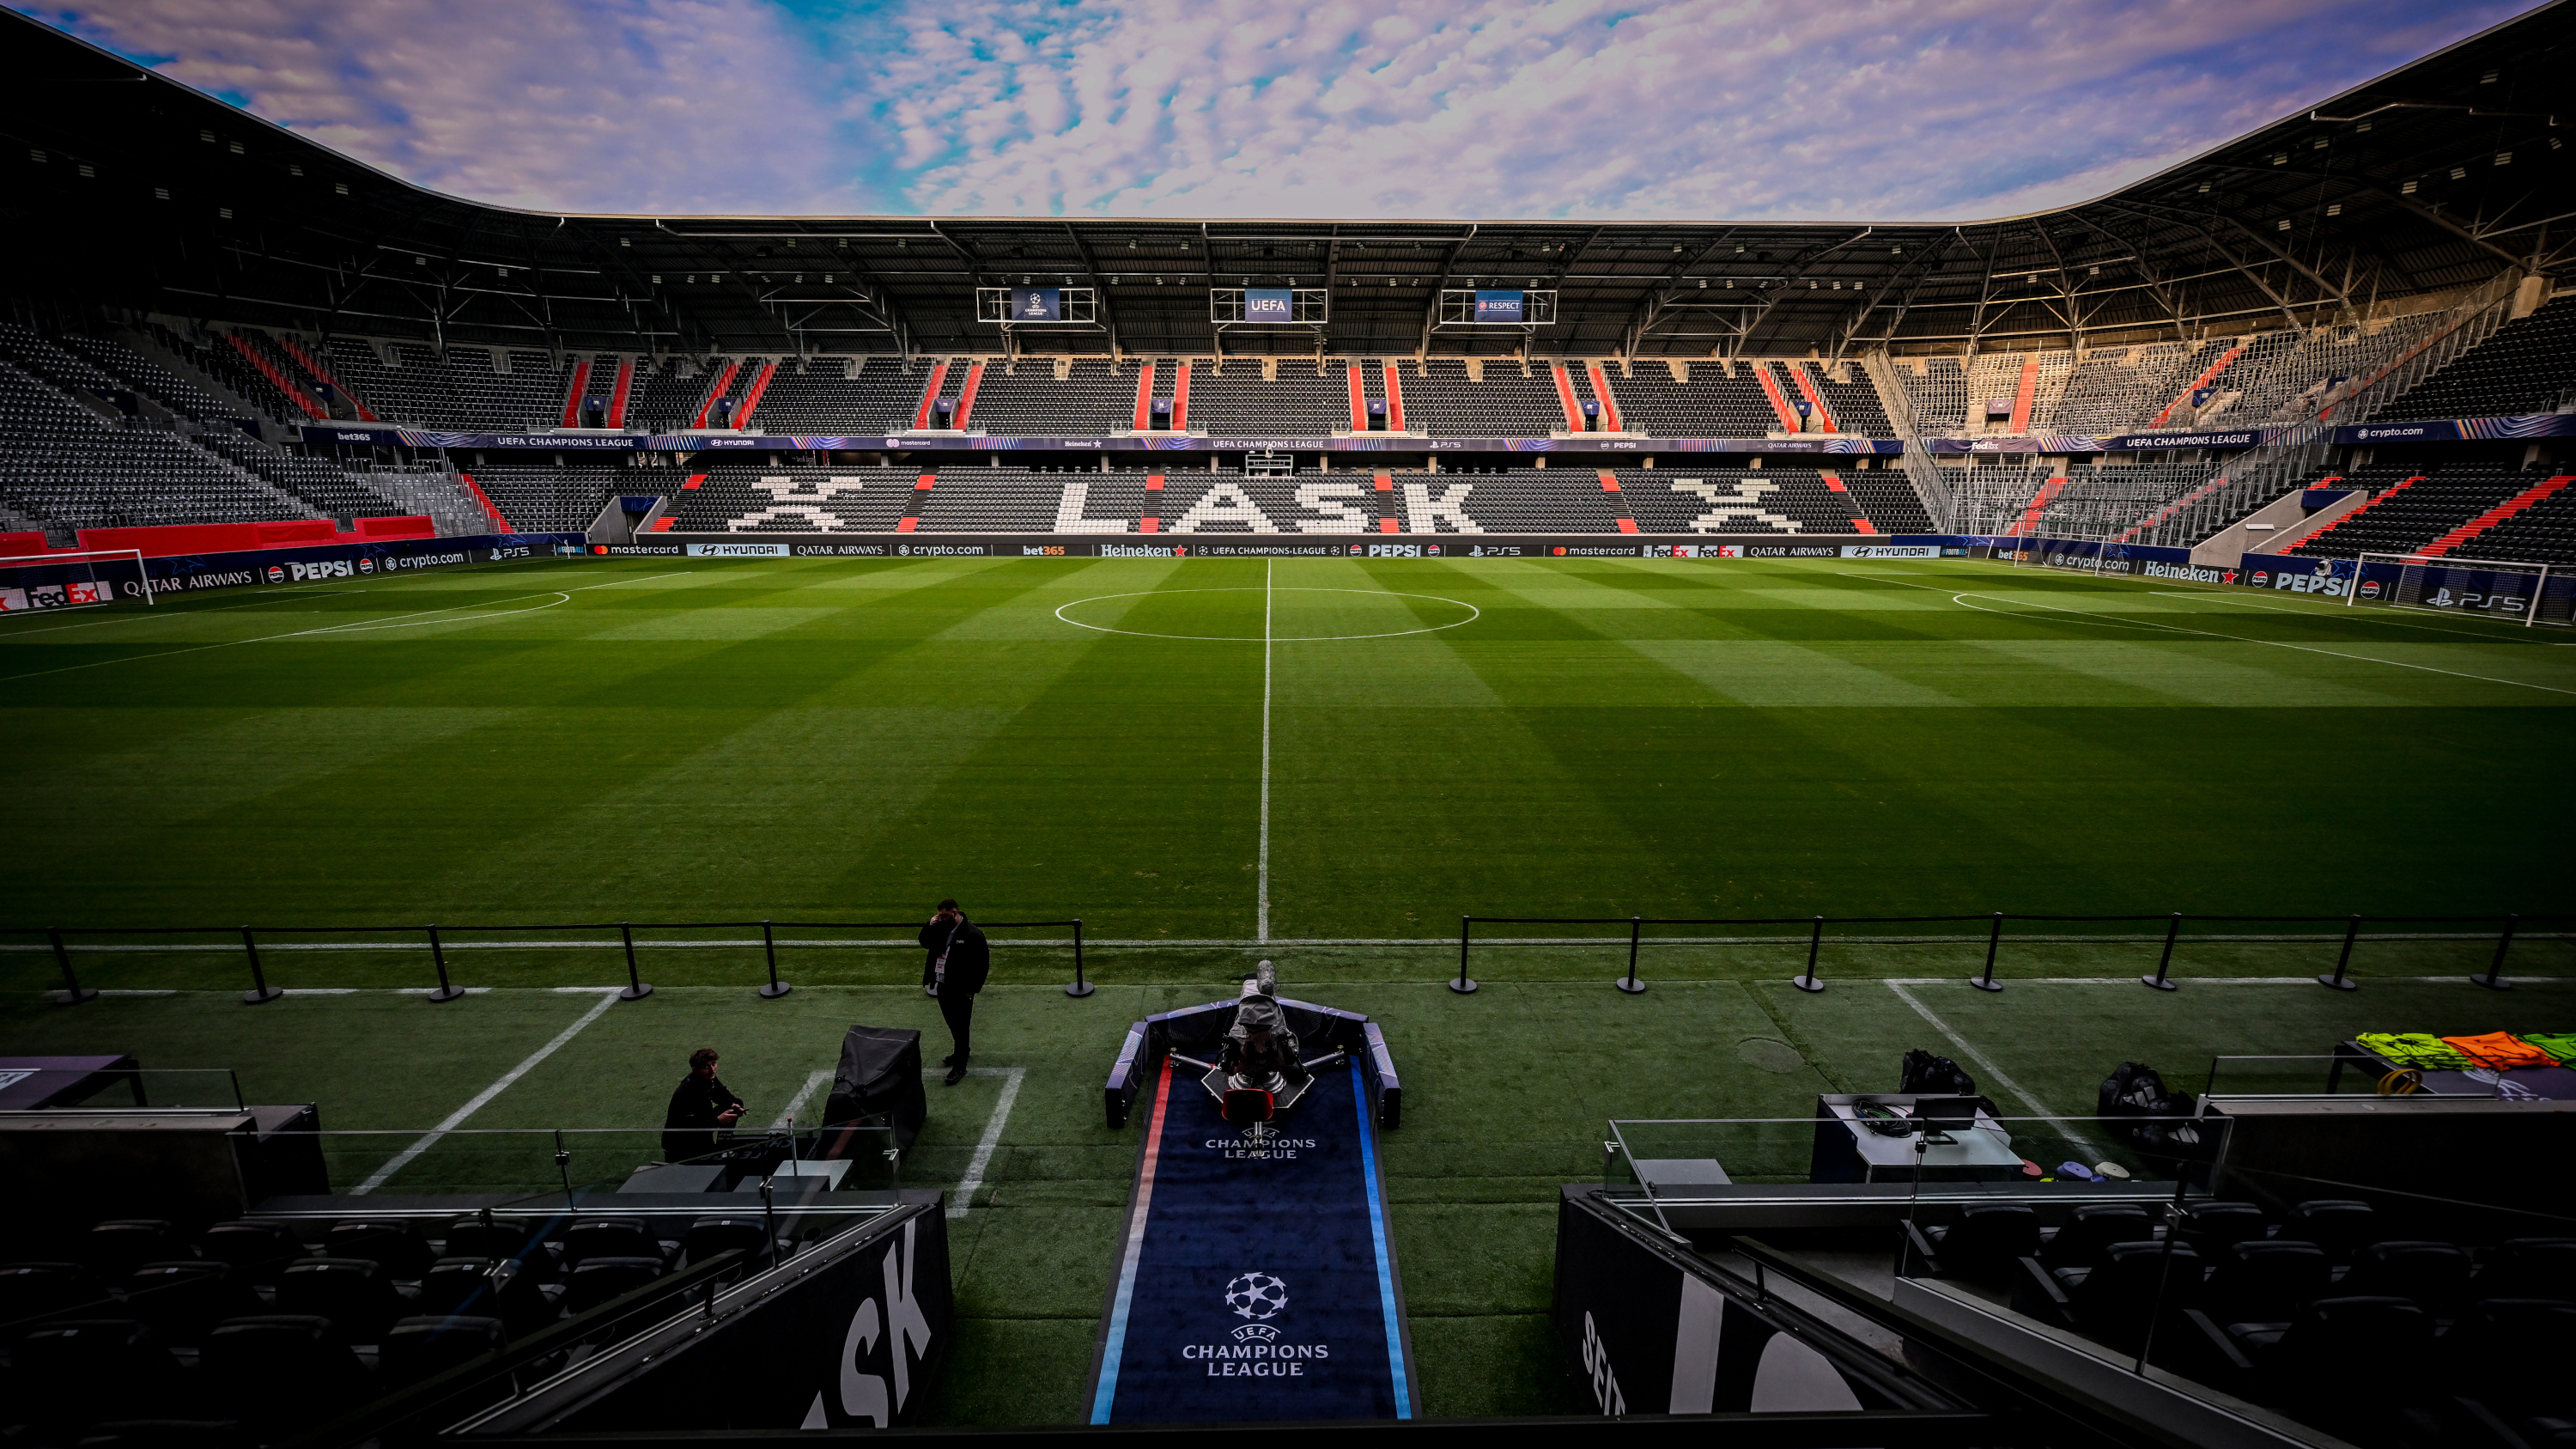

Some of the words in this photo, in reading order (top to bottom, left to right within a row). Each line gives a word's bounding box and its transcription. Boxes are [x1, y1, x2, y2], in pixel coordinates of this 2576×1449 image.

[1251, 300, 1286, 311] UEFA
[337, 432, 371, 441] bet365
[2370, 428, 2423, 437] crypto.com
[498, 437, 526, 446] UEFA
[530, 437, 593, 447] CHAMPIONS
[595, 438, 634, 447] LEAGUE
[1971, 441, 1999, 450] FedEx
[2127, 438, 2152, 447] UEFA
[2154, 436, 2209, 446] CHAMPIONS
[2212, 434, 2251, 444] LEAGUE
[1054, 483, 1484, 533] LASK
[503, 546, 530, 557] PS5
[611, 545, 679, 556] mastercard
[723, 545, 778, 555] HYUNDAI
[797, 545, 834, 556] QATAR
[838, 545, 882, 555] AIRWAYS
[913, 545, 984, 557] crypto.com
[1023, 545, 1065, 556] bet365
[1101, 544, 1172, 557] Heineken
[1237, 547, 1289, 555] CHAMPIONS
[1293, 547, 1326, 555] LEAGUE
[1369, 545, 1421, 557] PEPSI
[1487, 547, 1521, 556] PS5
[1570, 546, 1635, 556] mastercard
[1651, 545, 1689, 557] FedEx
[1698, 545, 1735, 557] FedEx
[1750, 547, 1787, 557] QATAR
[1789, 547, 1834, 557] AIRWAYS
[1876, 548, 1929, 557] HYUNDAI
[1998, 549, 2028, 561] bet365
[399, 552, 464, 569] crypto.com
[2067, 554, 2129, 572] crypto.com
[291, 560, 354, 581] PEPSI
[2144, 561, 2219, 584] Heineken
[124, 577, 183, 598] QATAR
[189, 570, 252, 590] AIRWAYS
[2275, 573, 2351, 597] PEPSI
[25, 583, 100, 606] FedEx
[2459, 593, 2526, 612] PS5
[1233, 1326, 1277, 1342] UEFA
[1182, 1344, 1328, 1359] CHAMPIONS
[1207, 1362, 1303, 1376] LEAGUE
[1583, 1310, 1626, 1416] SEIT
